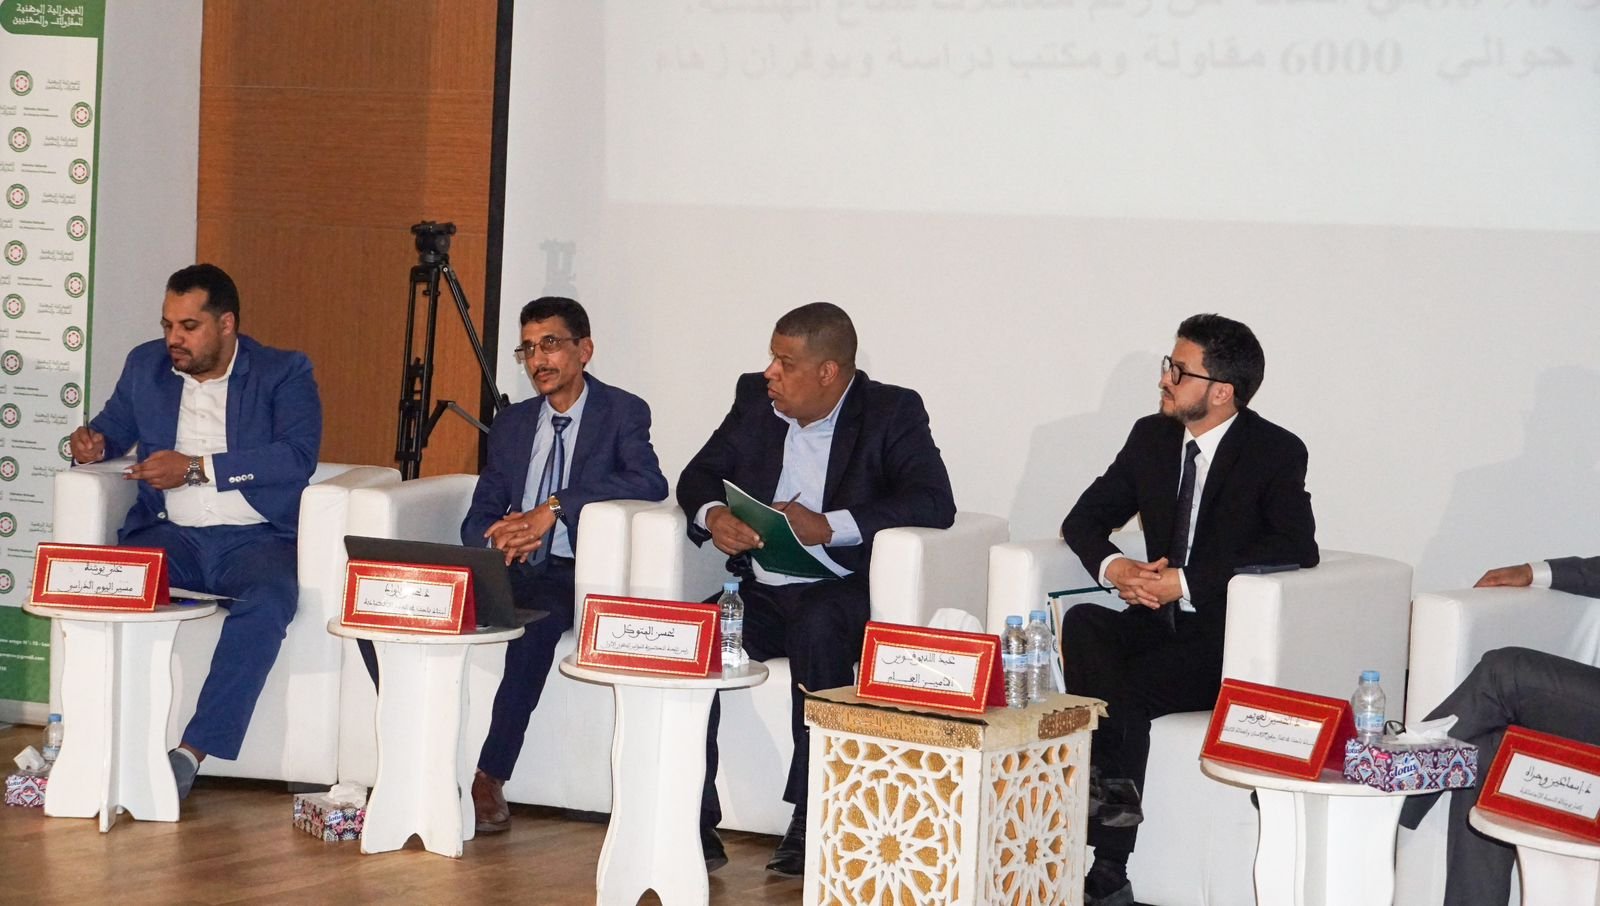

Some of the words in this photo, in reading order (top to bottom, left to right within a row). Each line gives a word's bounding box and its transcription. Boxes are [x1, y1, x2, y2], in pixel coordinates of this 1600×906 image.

[16, 3, 46, 15] الوطنية
[888, 35, 993, 79] دراسة
[1144, 33, 1266, 79] مقاولة
[1279, 37, 1404, 77] 6000
[96, 582, 114, 594] اليوم
[938, 655, 956, 665] عبد
[1393, 764, 1417, 777] lotus
